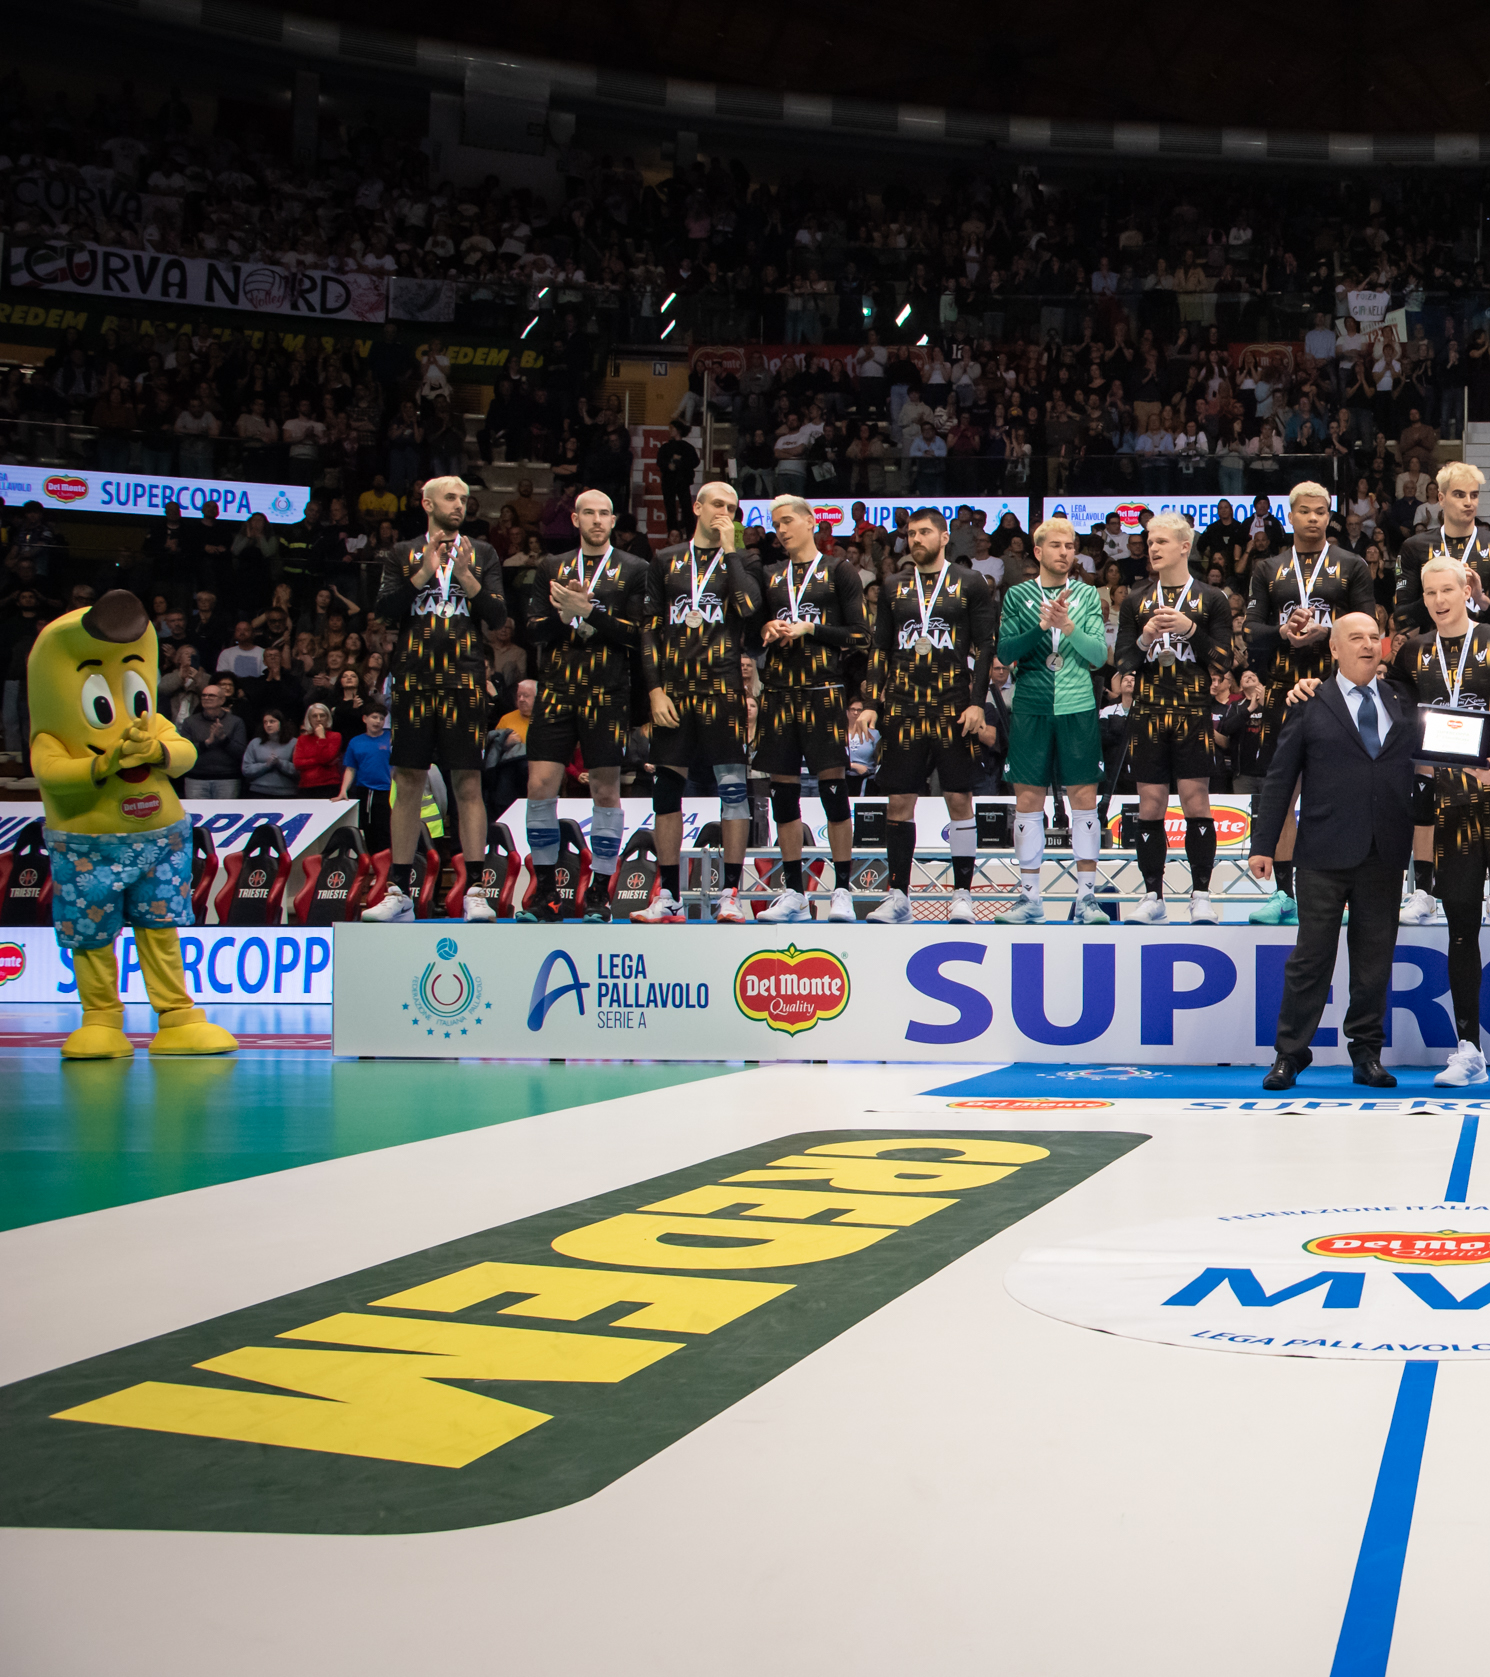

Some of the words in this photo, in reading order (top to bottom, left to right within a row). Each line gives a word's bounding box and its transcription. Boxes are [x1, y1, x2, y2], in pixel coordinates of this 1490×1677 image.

[23, 246, 188, 300] CURVA
[654, 362, 668, 376] N
[48, 482, 60, 490] Del
[61, 483, 86, 493] Monte
[101, 480, 251, 514] SUPERCOPPA
[1071, 512, 1105, 520] PALLAVOLO
[124, 803, 136, 812] Del
[136, 799, 160, 810] Monte
[10, 888, 41, 898] TRIESTE
[238, 888, 269, 899] TRIESTE
[317, 889, 348, 899] TRIESTE
[617, 890, 649, 899] TRIESTE
[597, 954, 648, 979] LEGA
[746, 973, 777, 996] Del
[780, 973, 842, 997] Monte
[468, 975, 483, 1015] PALLAVOLO
[597, 983, 709, 1010] PALLAVOLO
[769, 998, 815, 1017] Quality
[436, 1015, 468, 1027] ITALIANA
[597, 1010, 634, 1029] SERIE
[637, 1010, 647, 1029] A
[1217, 1206, 1398, 1222] FEDERAZIONE
[1329, 1239, 1402, 1250] Del
[1391, 1250, 1490, 1258] Quality
[48, 1137, 1051, 1469] CREDEM
[1191, 1329, 1275, 1346] LEGA
